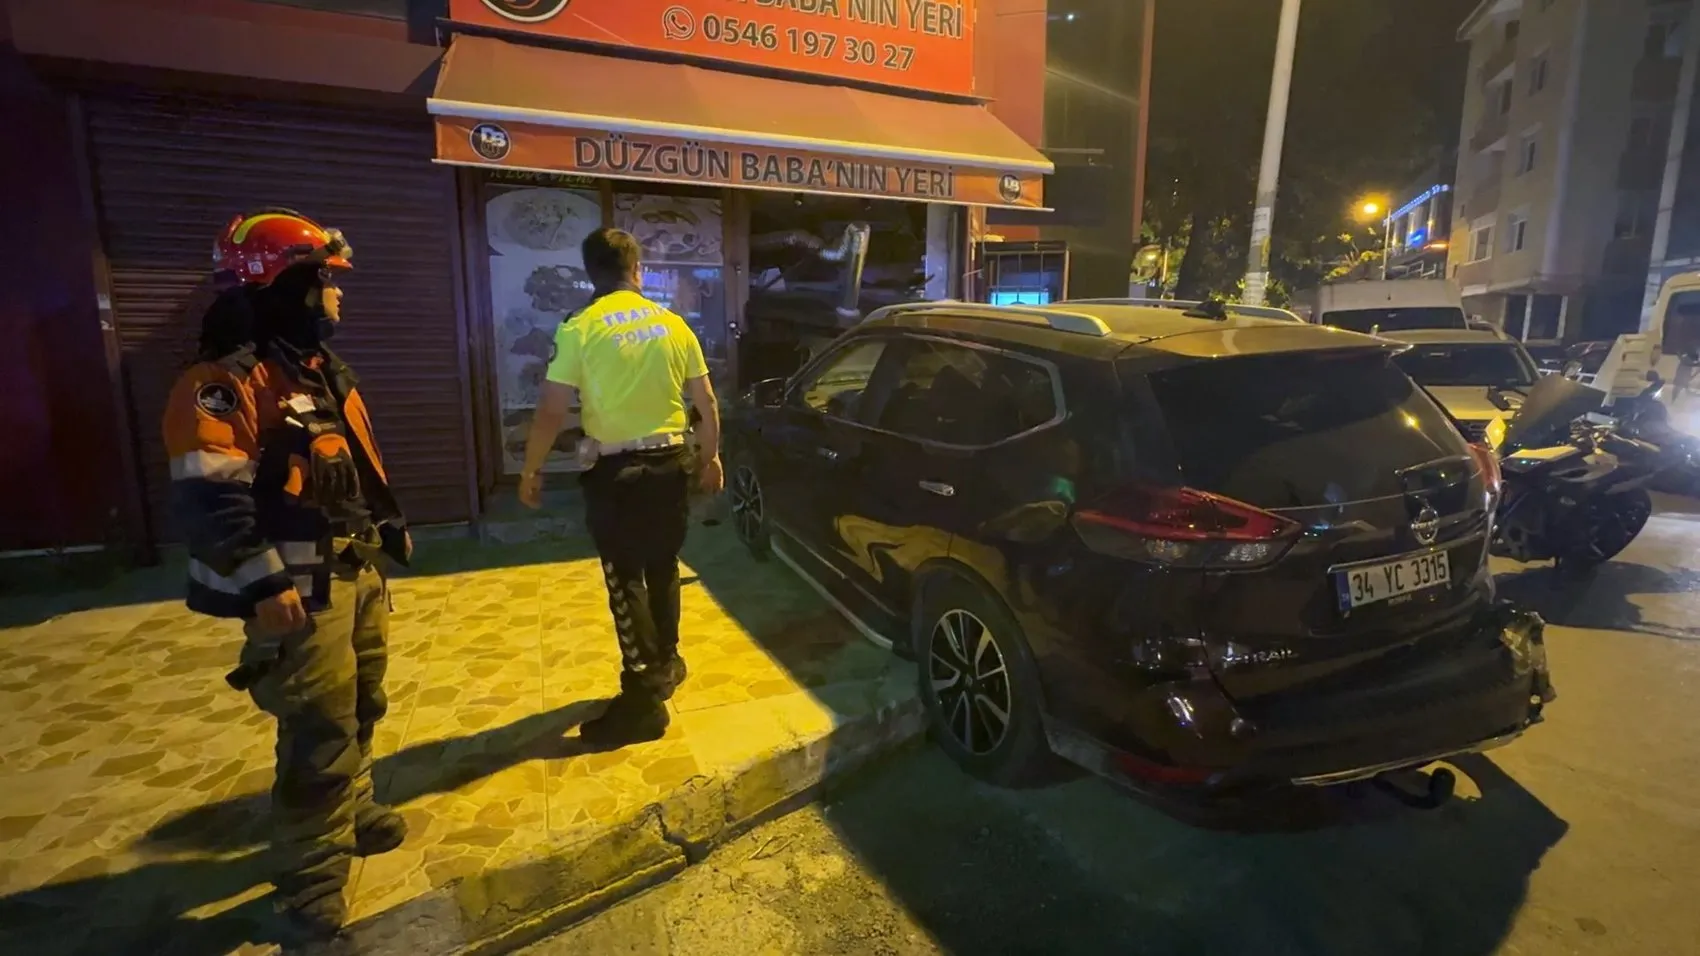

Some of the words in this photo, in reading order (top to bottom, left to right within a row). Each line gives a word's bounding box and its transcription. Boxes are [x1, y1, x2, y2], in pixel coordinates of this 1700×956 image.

[702, 14, 778, 50] 0546
[785, 27, 838, 59] 197
[843, 36, 876, 65] 30
[882, 42, 916, 71] 27
[757, 0, 898, 28] BANIN
[904, 0, 963, 40] YERİ
[574, 133, 732, 179] DÜZGÜN
[740, 152, 888, 194] BABA'NIN
[894, 164, 954, 198] YERİ
[1353, 571, 1374, 602] 34
[1384, 563, 1405, 593] YC
[1411, 554, 1447, 586] 3315
